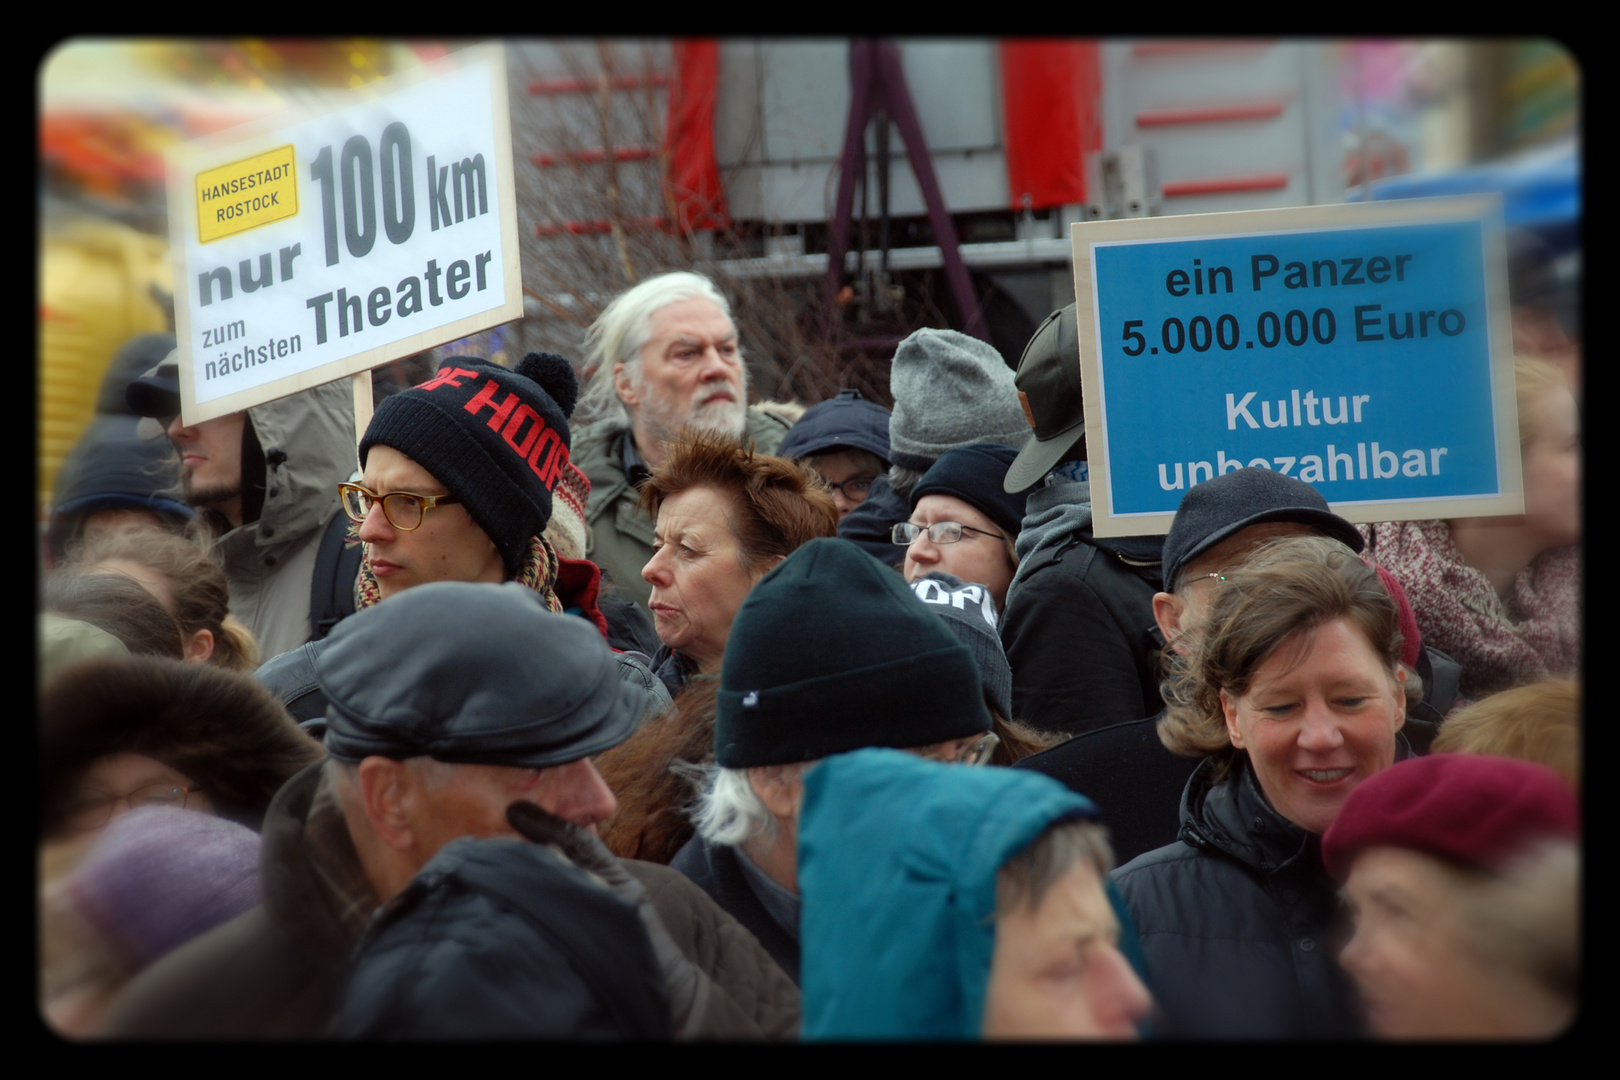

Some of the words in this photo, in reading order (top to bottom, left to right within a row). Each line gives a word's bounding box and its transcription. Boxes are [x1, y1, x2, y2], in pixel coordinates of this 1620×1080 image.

[202, 163, 290, 202] HANSESTADT
[198, 242, 302, 307] nur
[310, 121, 416, 268] 100
[426, 152, 489, 232] km
[216, 191, 280, 223] ROSTOCK
[1165, 258, 1234, 297] ein
[1250, 254, 1414, 291] Panzer
[202, 319, 246, 349] zum
[204, 334, 302, 380] nächsten
[306, 250, 492, 345] Theater
[1121, 307, 1337, 357] 5.000.000
[1354, 304, 1467, 343] Euro
[1224, 389, 1370, 431] Kultur
